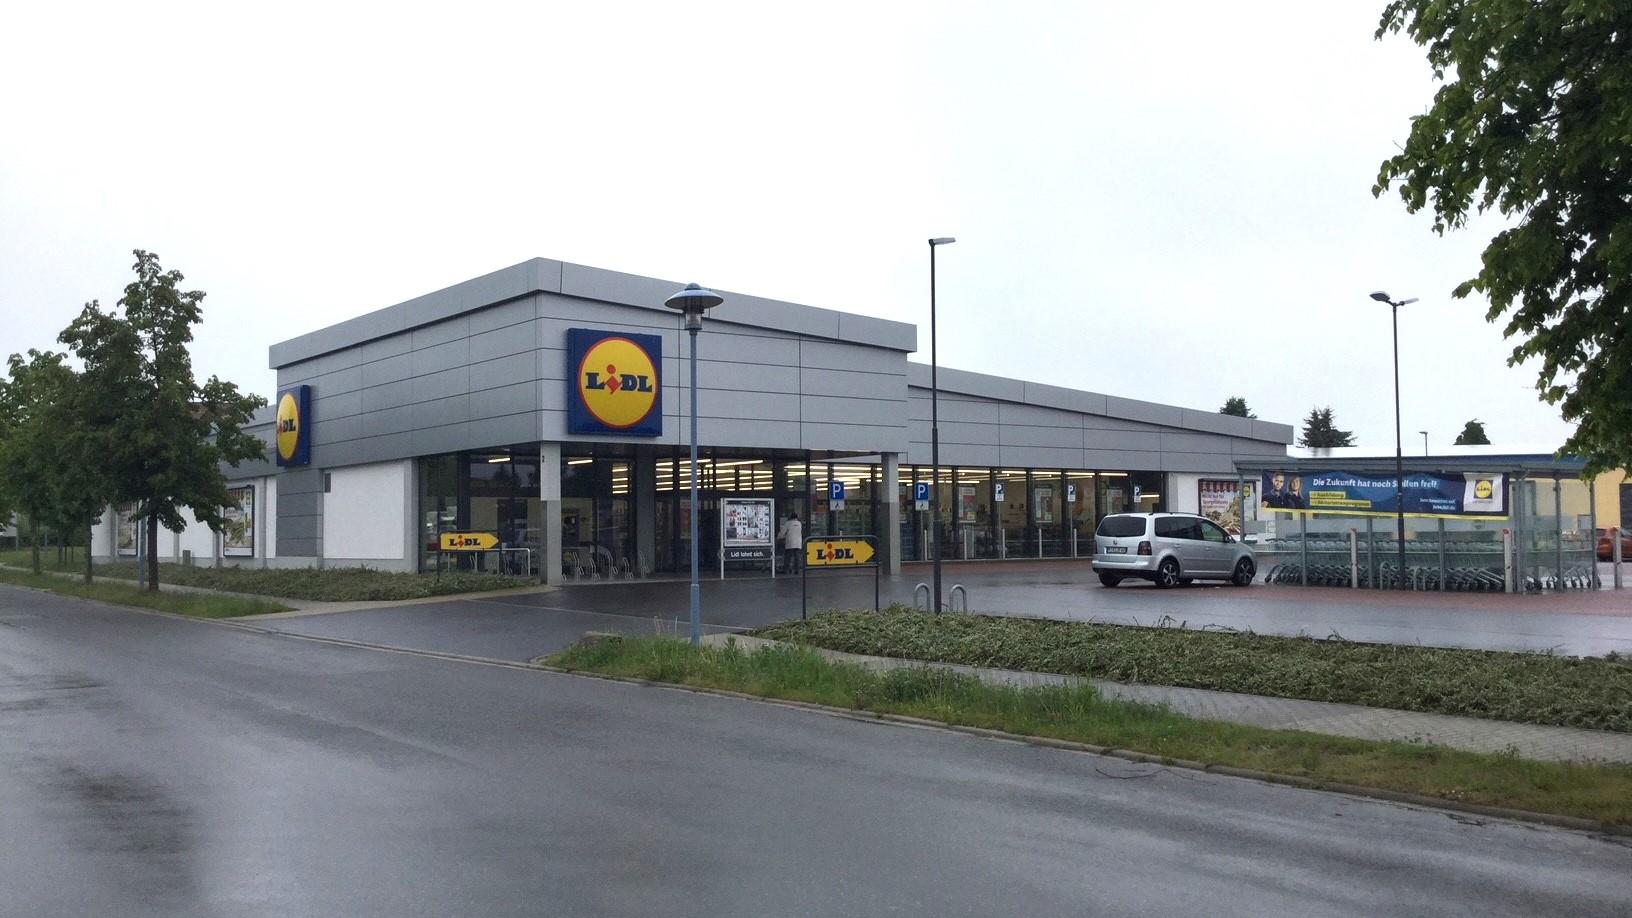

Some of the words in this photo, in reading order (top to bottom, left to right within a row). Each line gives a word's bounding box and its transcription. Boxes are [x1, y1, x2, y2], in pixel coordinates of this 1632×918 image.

[1326, 478, 1356, 487] Zukunft
[1357, 479, 1371, 487] hat
[1371, 480, 1391, 488] noch
[832, 484, 841, 498] P
[918, 484, 926, 499] P
[995, 484, 1002, 494] P
[1068, 485, 1074, 495] P
